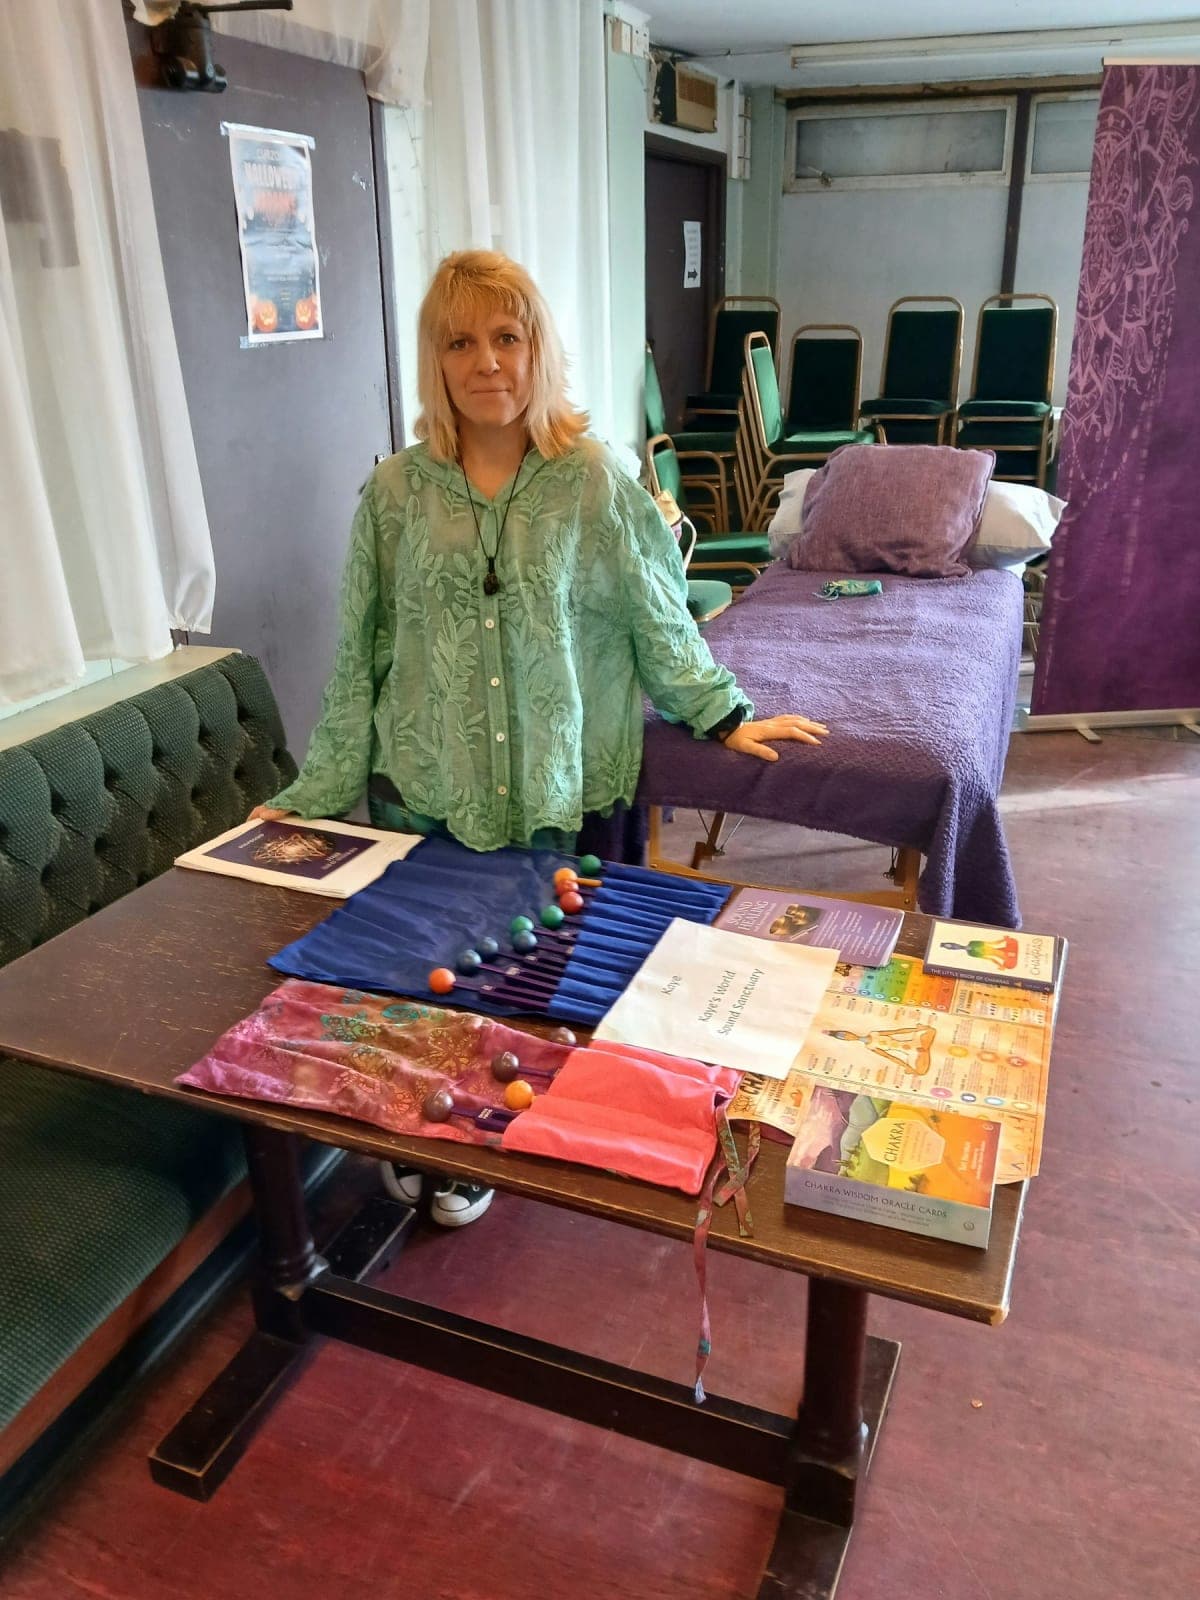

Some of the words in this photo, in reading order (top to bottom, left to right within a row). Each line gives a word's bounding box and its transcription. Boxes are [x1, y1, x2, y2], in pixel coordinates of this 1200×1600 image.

[738, 901, 769, 931] HEALING
[660, 975, 682, 996] Kaye
[698, 996, 722, 1022] Kaye's
[713, 970, 737, 995] World
[717, 1010, 741, 1035] Sound
[732, 968, 766, 1010] Sanctuary
[883, 1122, 905, 1162] CHAKRA
[804, 1180, 841, 1195] CHAKRA
[841, 1188, 879, 1203] WISDOM
[881, 1198, 916, 1212] ORACLE
[918, 1206, 948, 1219] CARDS
